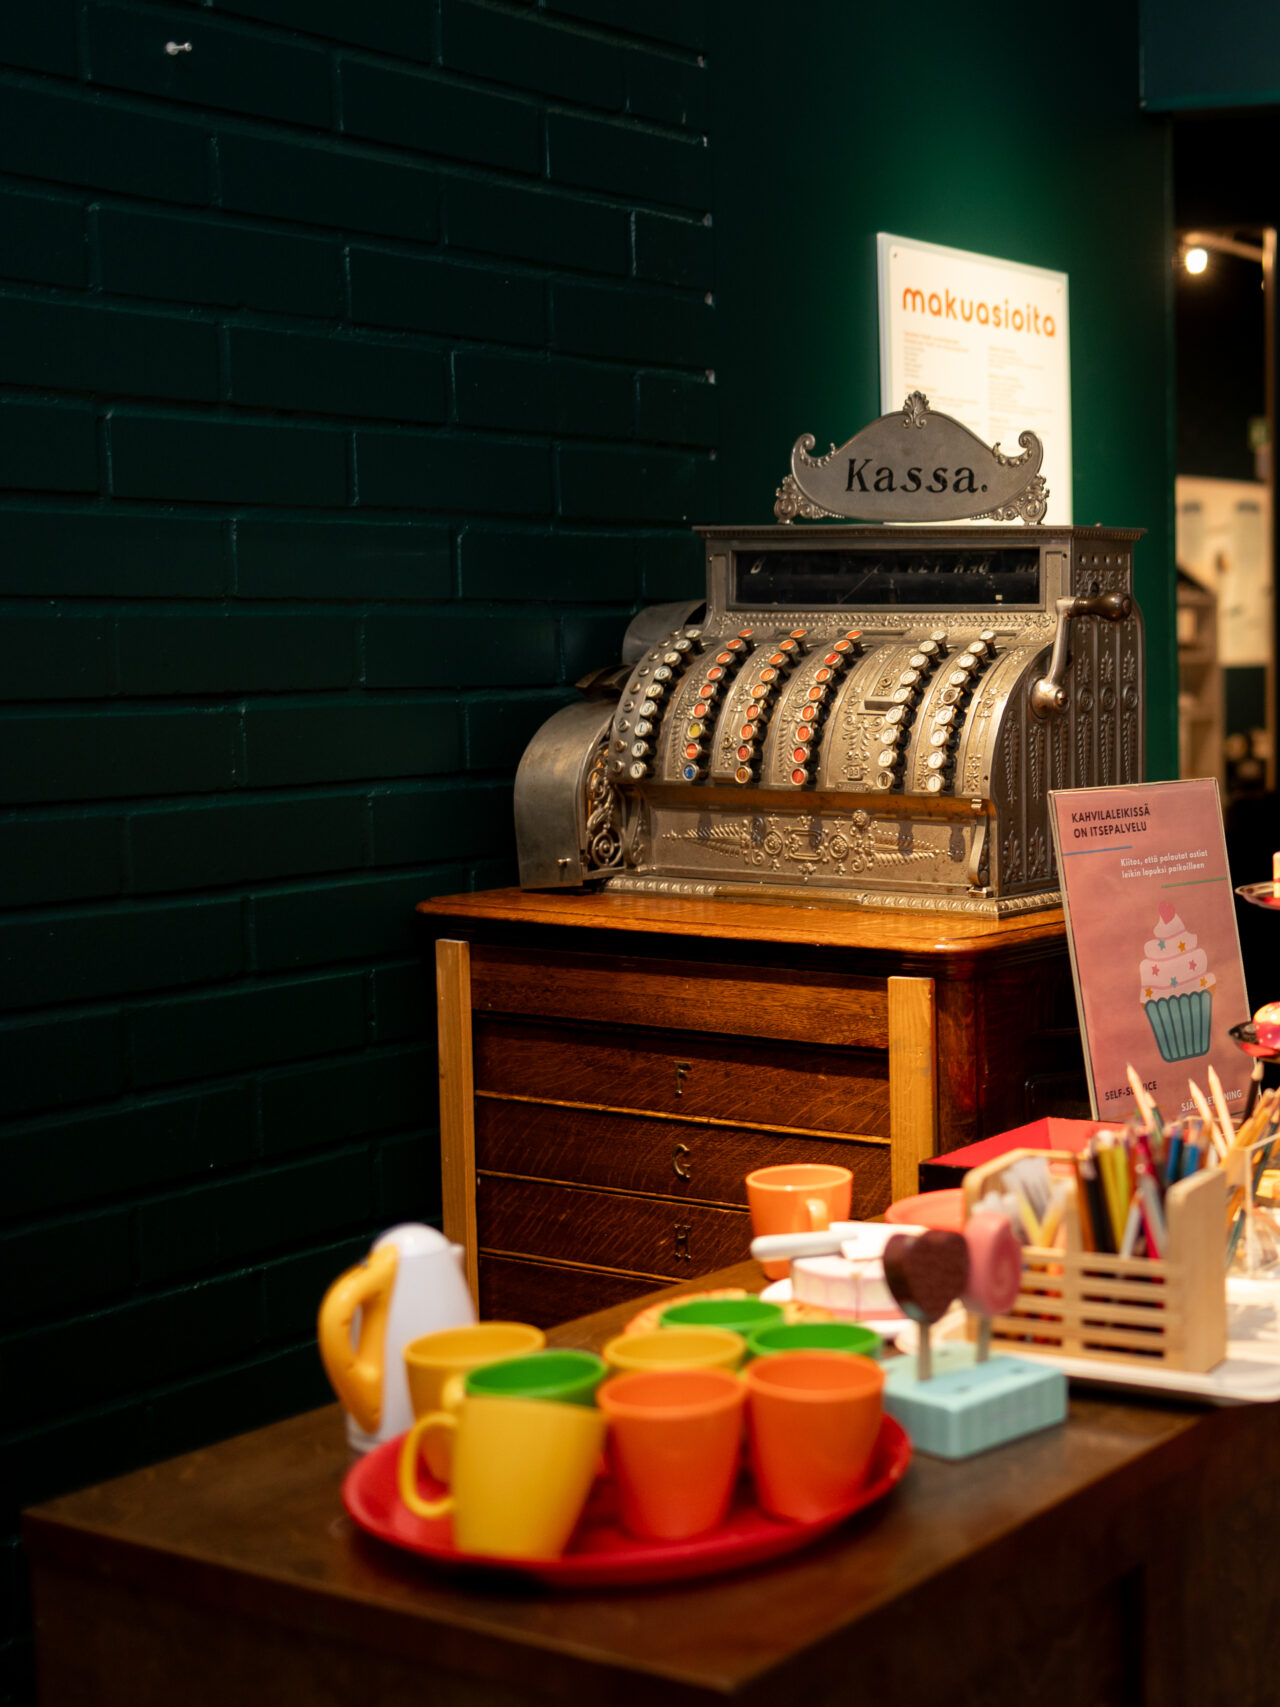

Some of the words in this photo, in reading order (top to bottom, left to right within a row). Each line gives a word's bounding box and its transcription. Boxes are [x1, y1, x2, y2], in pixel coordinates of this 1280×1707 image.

[902, 286, 1057, 338] makuasioita
[844, 458, 988, 494] Kassa.
[1071, 803, 1151, 823] KAHVILALEIKISSÄ
[1073, 827, 1088, 839] ON
[1090, 821, 1147, 838] ITSEPALVELU
[1120, 858, 1143, 867] Kiitos,
[1144, 856, 1158, 864] että
[1159, 852, 1188, 865] palautat
[1189, 849, 1208, 859] astiat
[1121, 869, 1141, 879] leikin
[1142, 867, 1167, 878] lopuksi
[1168, 862, 1205, 875] paikoilleen
[672, 1061, 693, 1096] F
[1104, 1081, 1157, 1100] SELF-SICE
[673, 1223, 692, 1262] H
